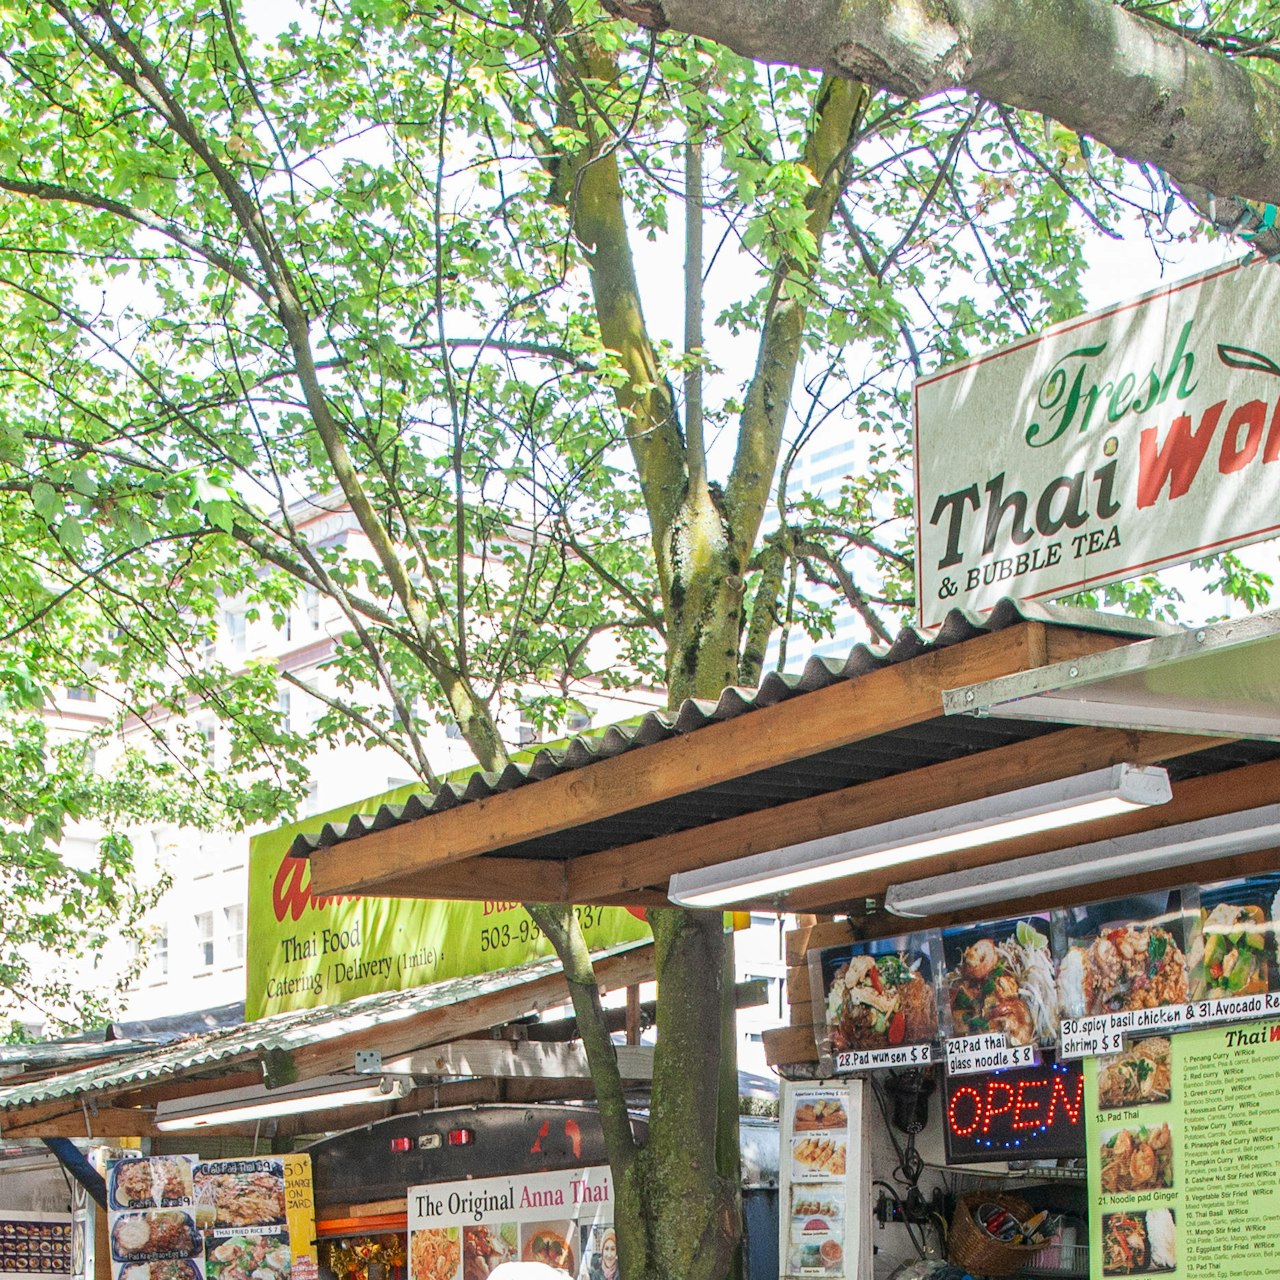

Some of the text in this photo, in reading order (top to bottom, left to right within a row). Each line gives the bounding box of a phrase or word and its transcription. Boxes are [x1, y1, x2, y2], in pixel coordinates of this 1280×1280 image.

[1026, 321, 1199, 448] Fresh
[930, 438, 1120, 570] Thai
[938, 524, 1121, 600] & BUBBLE TEA
[282, 920, 360, 963] Thai Food
[267, 971, 322, 999] Catering
[335, 957, 392, 984] Delivery
[1111, 1013, 1134, 1028] basil
[1138, 1009, 1180, 1024] chicken
[1186, 1005, 1194, 1019] &
[985, 1035, 1004, 1048] thai
[1064, 1035, 1120, 1053] shrimp $ 8
[1226, 1024, 1267, 1047] Thai
[910, 1048, 917, 1062] $
[922, 1048, 928, 1060] 8
[951, 1048, 1030, 1073] glass noodle $ 8
[949, 1074, 1085, 1136] OPEN
[1096, 1111, 1139, 1122] 13. Pad Thai
[289, 1190, 303, 1198] ON
[417, 1178, 609, 1221] The Original Anna Thai
[1098, 1191, 1179, 1205] 21. Noodle pad Ginger
